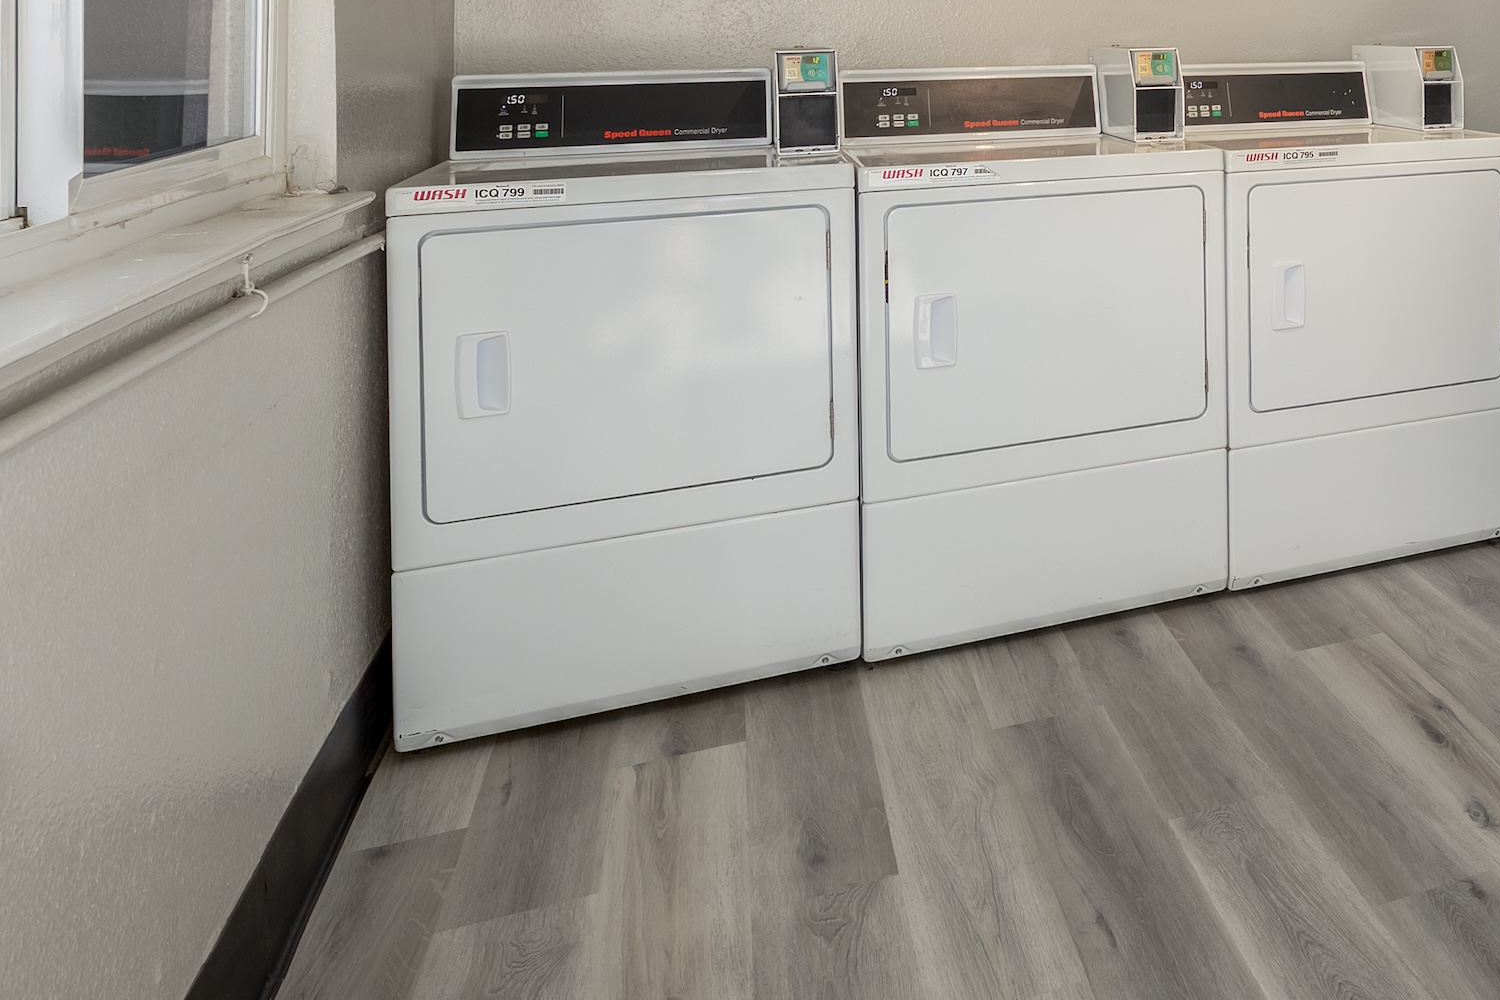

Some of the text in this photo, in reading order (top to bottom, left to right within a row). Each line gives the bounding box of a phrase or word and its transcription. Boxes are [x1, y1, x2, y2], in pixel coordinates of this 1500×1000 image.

[964, 120, 990, 128] Speed
[1020, 118, 1049, 126] Commercial
[604, 130, 637, 139] Speed
[639, 129, 671, 137] Queen
[711, 127, 727, 135] Dryer
[1246, 153, 1278, 162] WASH
[1283, 152, 1298, 160] ICQ
[882, 168, 968, 179] WASH ICQ 797
[413, 189, 467, 201] WASH
[475, 189, 499, 198] ICQ
[502, 188, 525, 197] 799
